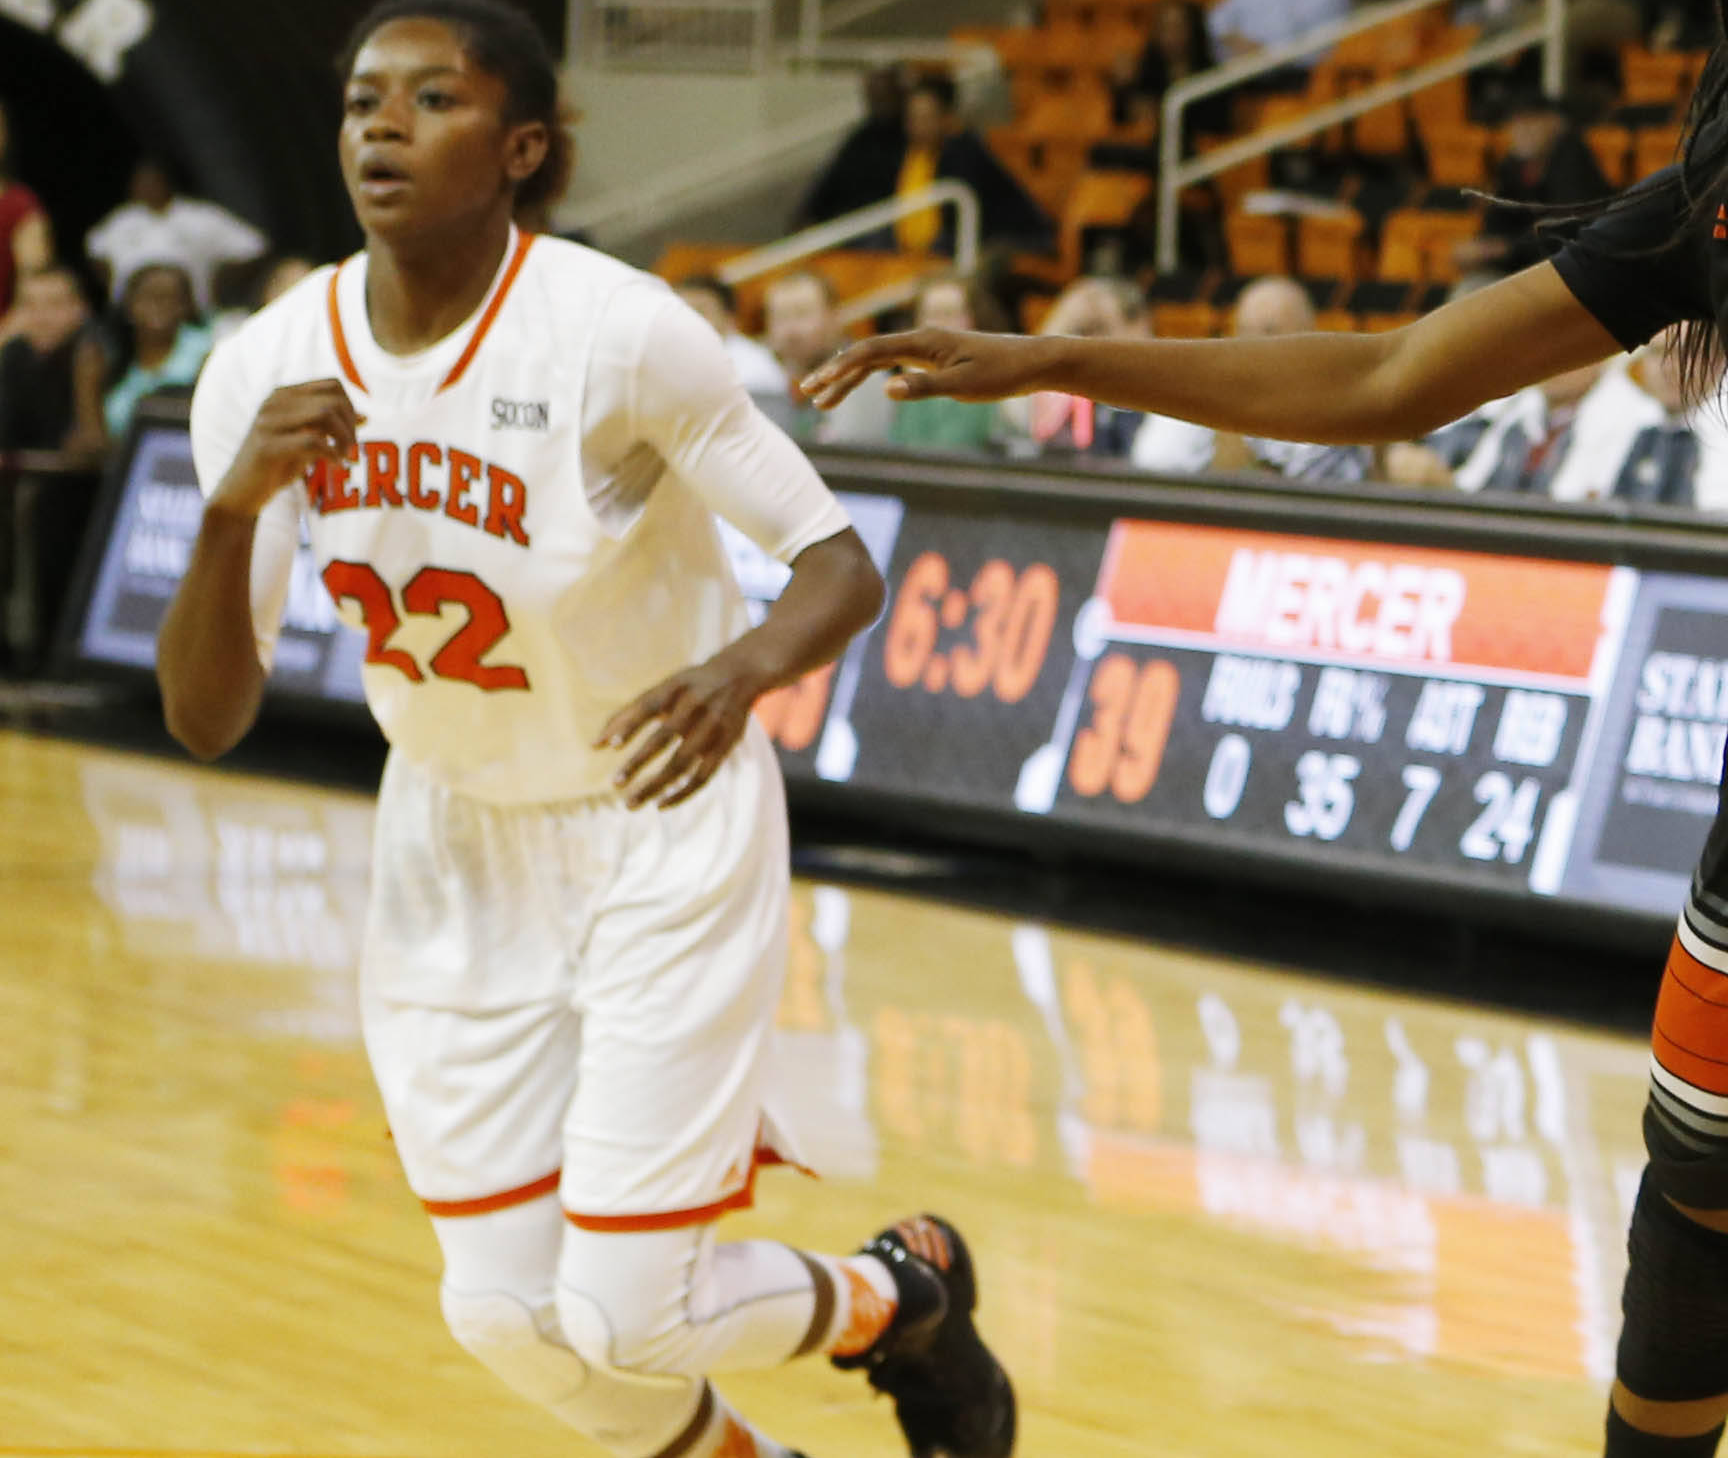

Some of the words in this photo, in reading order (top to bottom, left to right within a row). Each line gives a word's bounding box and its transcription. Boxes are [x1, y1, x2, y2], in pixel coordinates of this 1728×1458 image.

[322, 558, 532, 693] 22
[884, 551, 1060, 704] 6:30
[1215, 548, 1466, 663] MERCER
[1069, 653, 1181, 803] 39
[1284, 749, 1362, 841] 35
[1390, 764, 1442, 852] 7
[1460, 771, 1540, 864] 24
